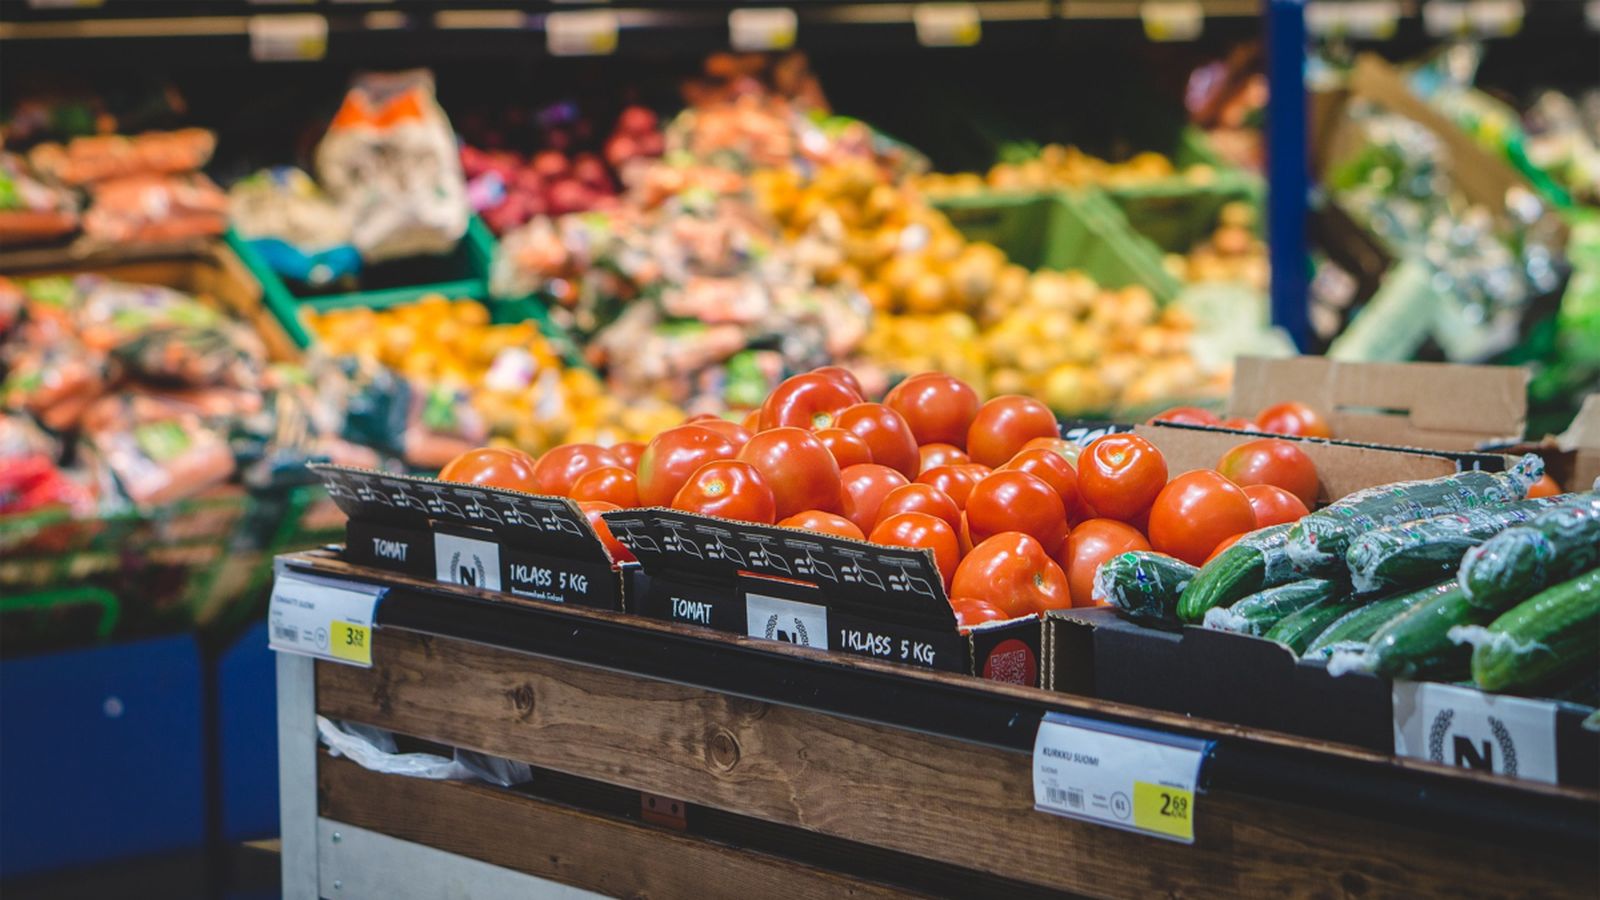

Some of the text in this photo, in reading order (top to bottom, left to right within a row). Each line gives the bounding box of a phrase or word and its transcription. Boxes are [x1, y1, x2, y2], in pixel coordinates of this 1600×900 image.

[373, 538, 408, 561] TOMAT
[460, 565, 476, 586] N
[560, 572, 566, 589] 5
[569, 573, 588, 594] KG
[670, 597, 713, 624] TOMAT
[901, 640, 910, 659] 5
[913, 641, 936, 666] KG
[1043, 747, 1099, 766] KURKKU SUOMI
[1453, 735, 1494, 775] N
[1115, 799, 1125, 811] 61
